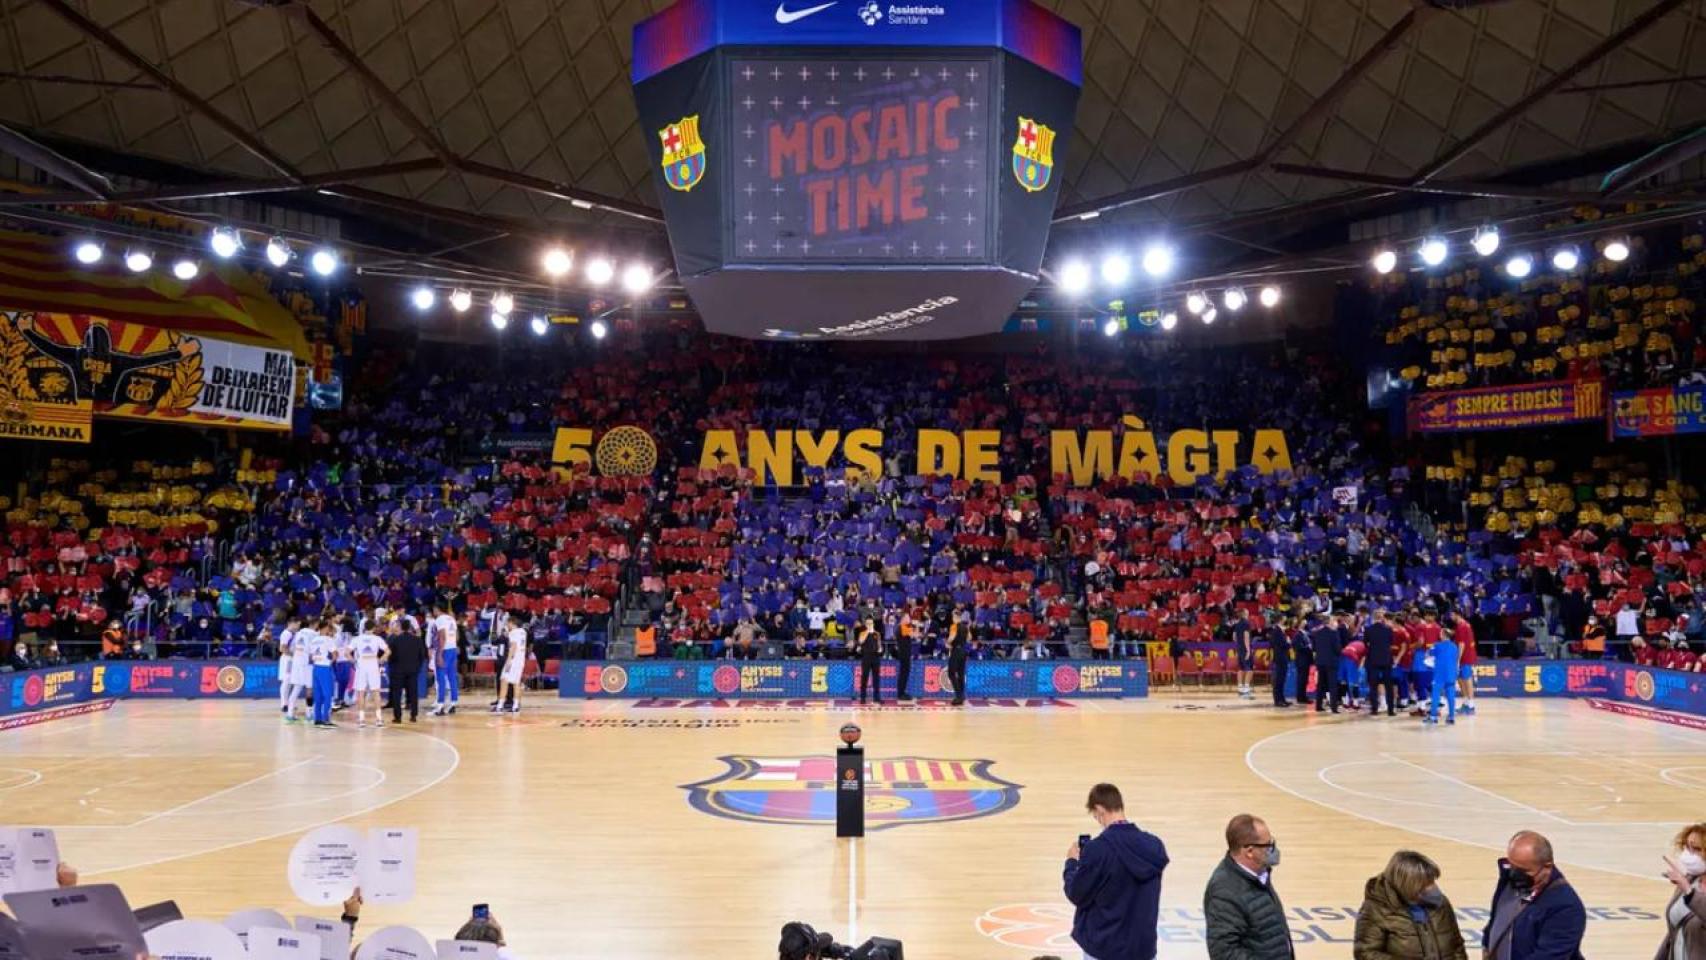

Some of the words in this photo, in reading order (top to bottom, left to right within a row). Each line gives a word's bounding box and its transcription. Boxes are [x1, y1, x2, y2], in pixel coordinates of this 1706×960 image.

[769, 96, 960, 179] MOSAIC
[807, 165, 929, 235] TIME
[264, 352, 293, 376] MAI
[212, 366, 292, 396] DEIXAREM
[202, 384, 224, 407] DE
[226, 387, 288, 418] LLUITAR
[1456, 394, 1509, 415] SEMPRE
[1512, 388, 1562, 411] FIDELS!
[1653, 391, 1703, 415] SANG
[699, 428, 883, 487] ANYS
[917, 428, 1000, 485] DE
[1051, 413, 1292, 487] MÀGIA
